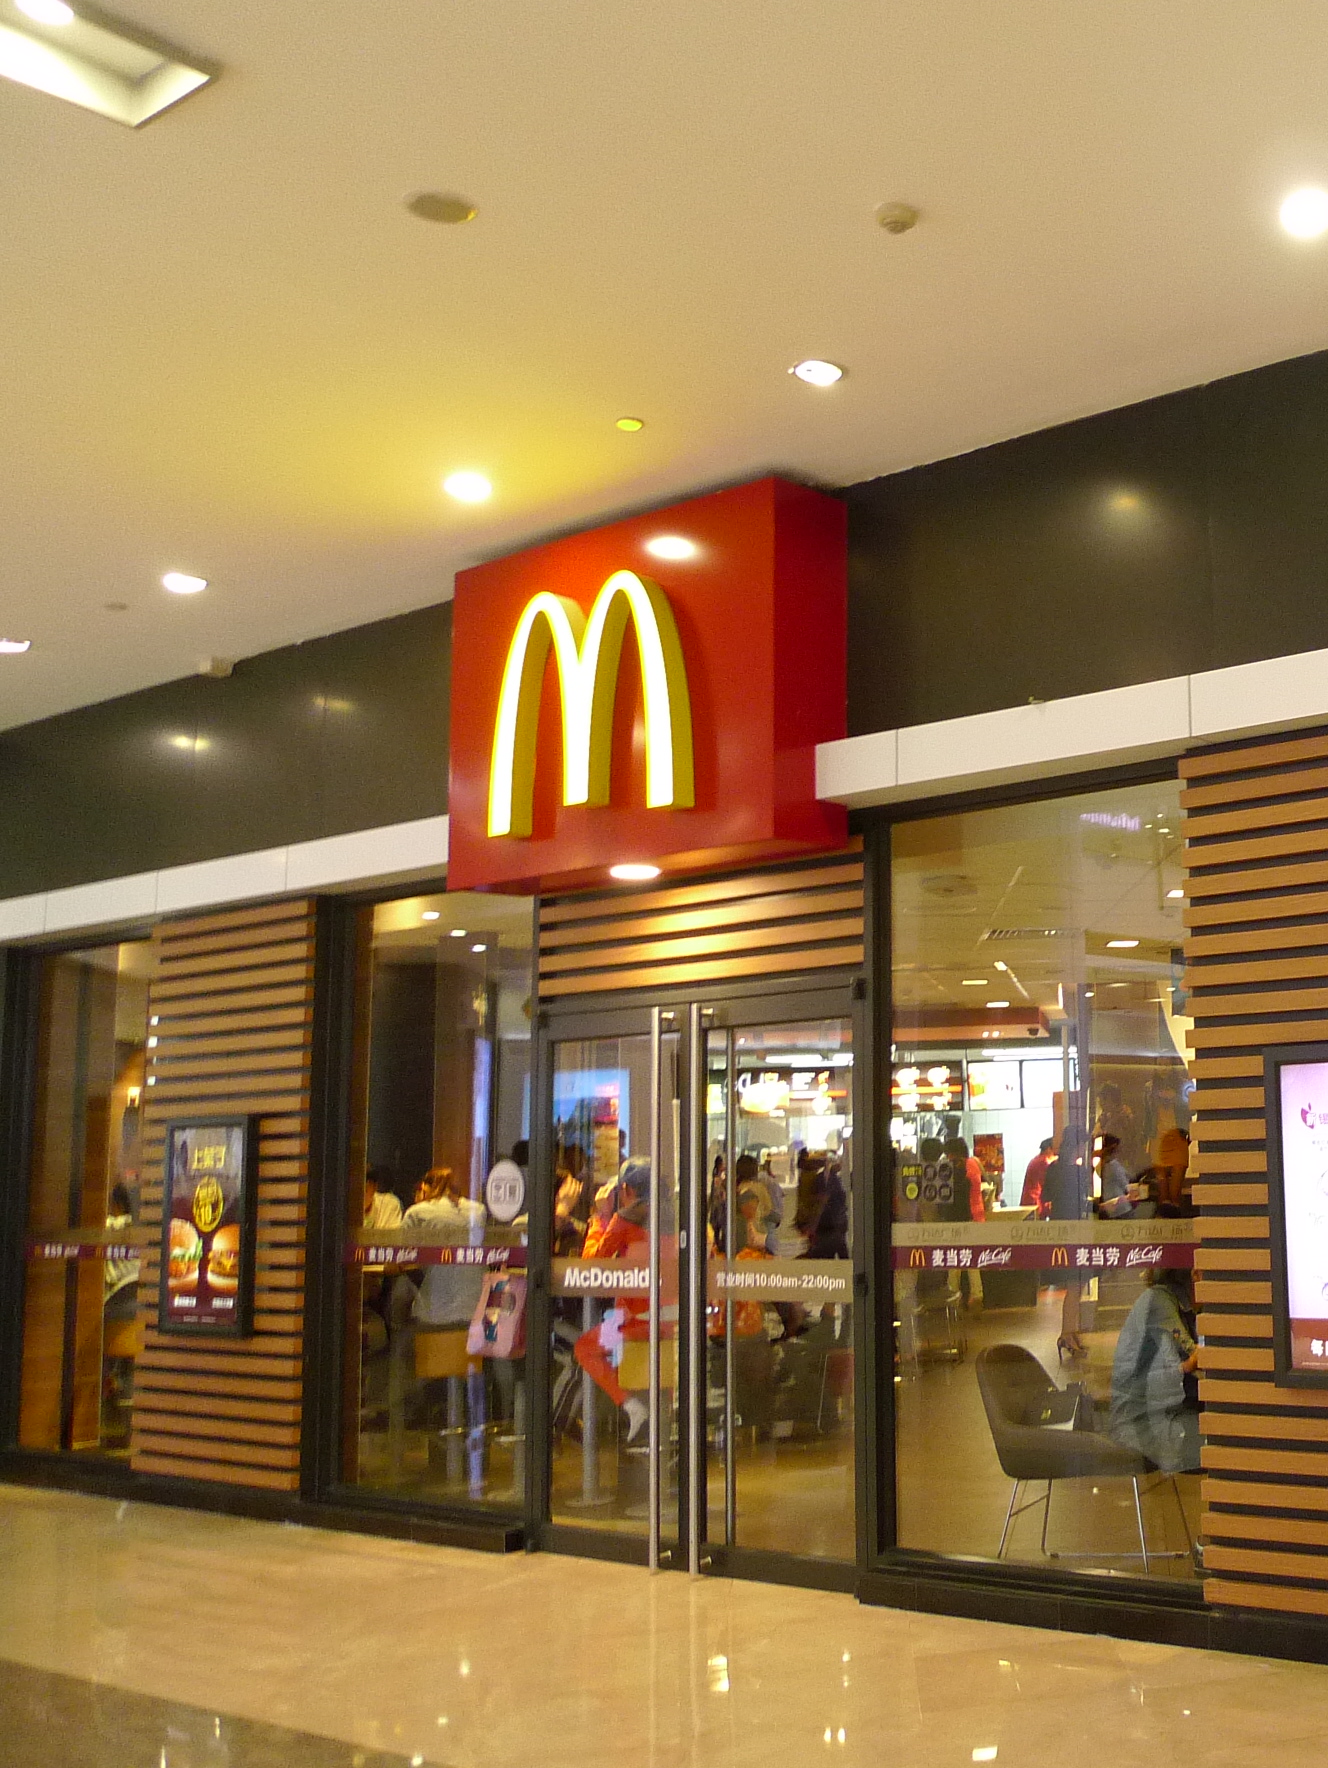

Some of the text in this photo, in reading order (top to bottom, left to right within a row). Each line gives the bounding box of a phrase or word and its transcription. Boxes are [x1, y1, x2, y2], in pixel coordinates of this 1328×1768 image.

[931, 1249, 972, 1267] 麦当劳
[1075, 1248, 1120, 1266] 麦当劳
[564, 1266, 662, 1289] McDonald
